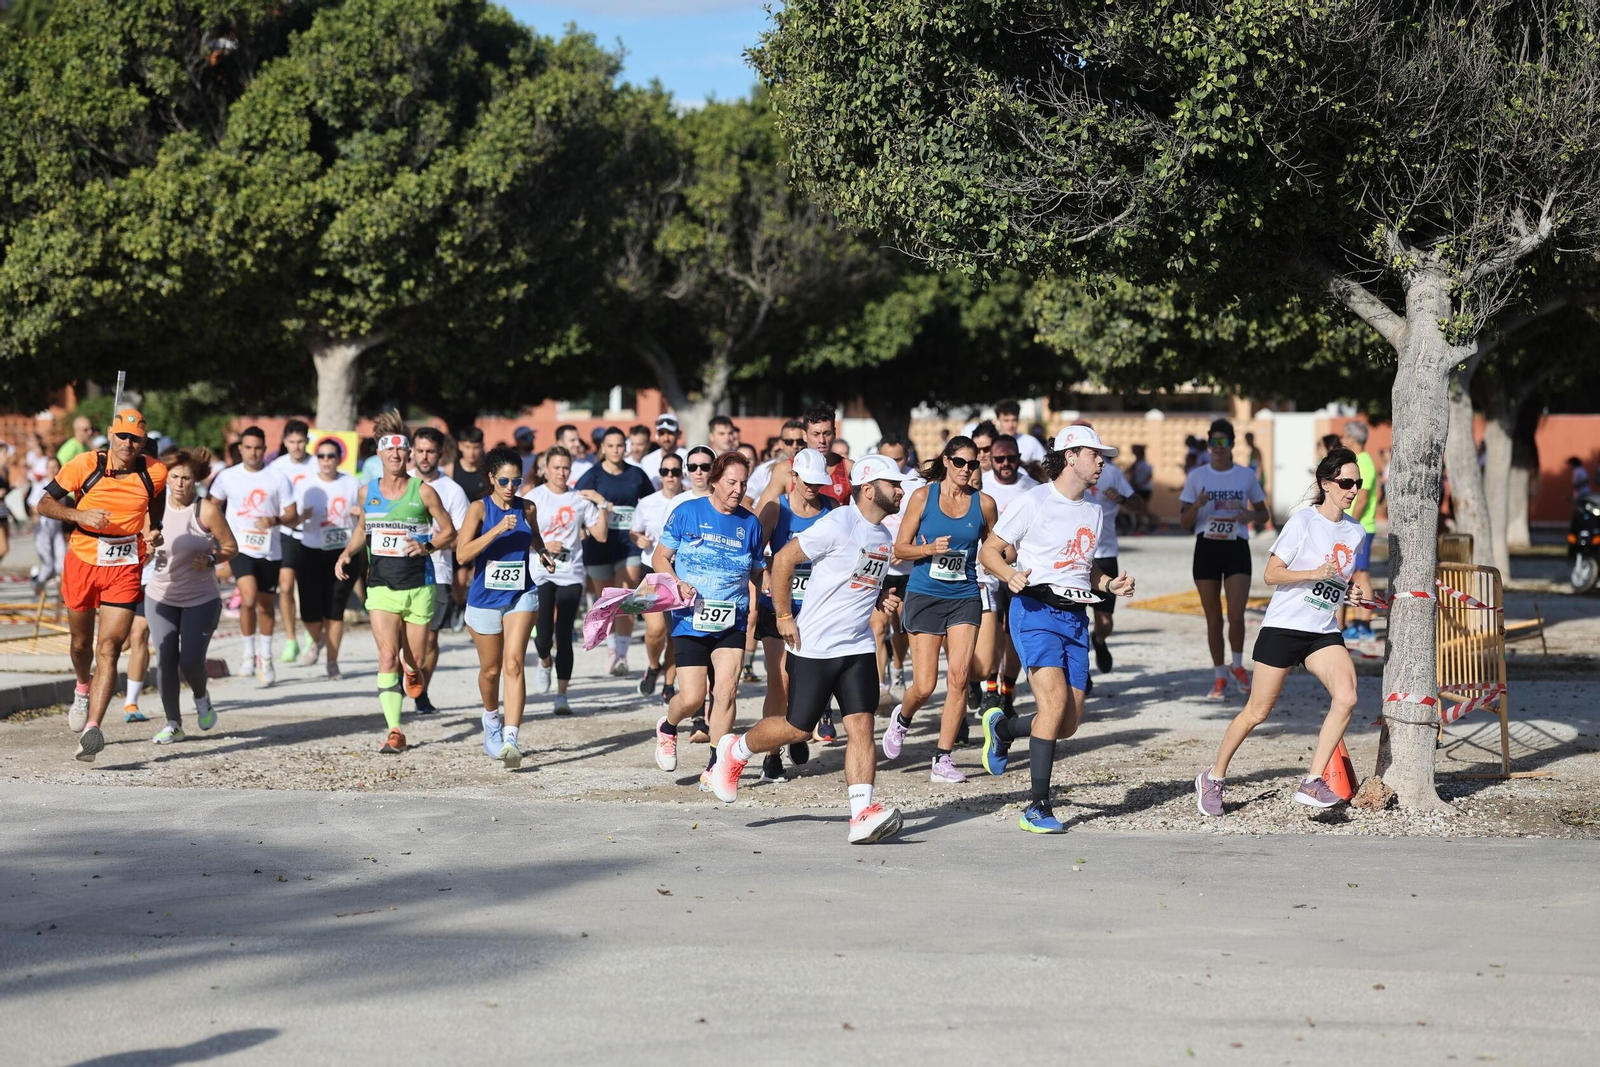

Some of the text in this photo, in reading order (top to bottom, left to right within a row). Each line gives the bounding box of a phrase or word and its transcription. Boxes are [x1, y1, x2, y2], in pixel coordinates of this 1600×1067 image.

[1206, 490, 1244, 501] DERESAS
[1210, 522, 1234, 534] 203
[245, 534, 266, 546] 168
[325, 531, 347, 544] 538
[382, 536, 398, 548] 81
[105, 544, 132, 557] 419
[863, 560, 884, 577] 411
[937, 557, 963, 571] 908
[491, 569, 521, 581] 483
[1063, 588, 1093, 599] 410
[1312, 581, 1341, 603] 869
[700, 608, 732, 622] 597
